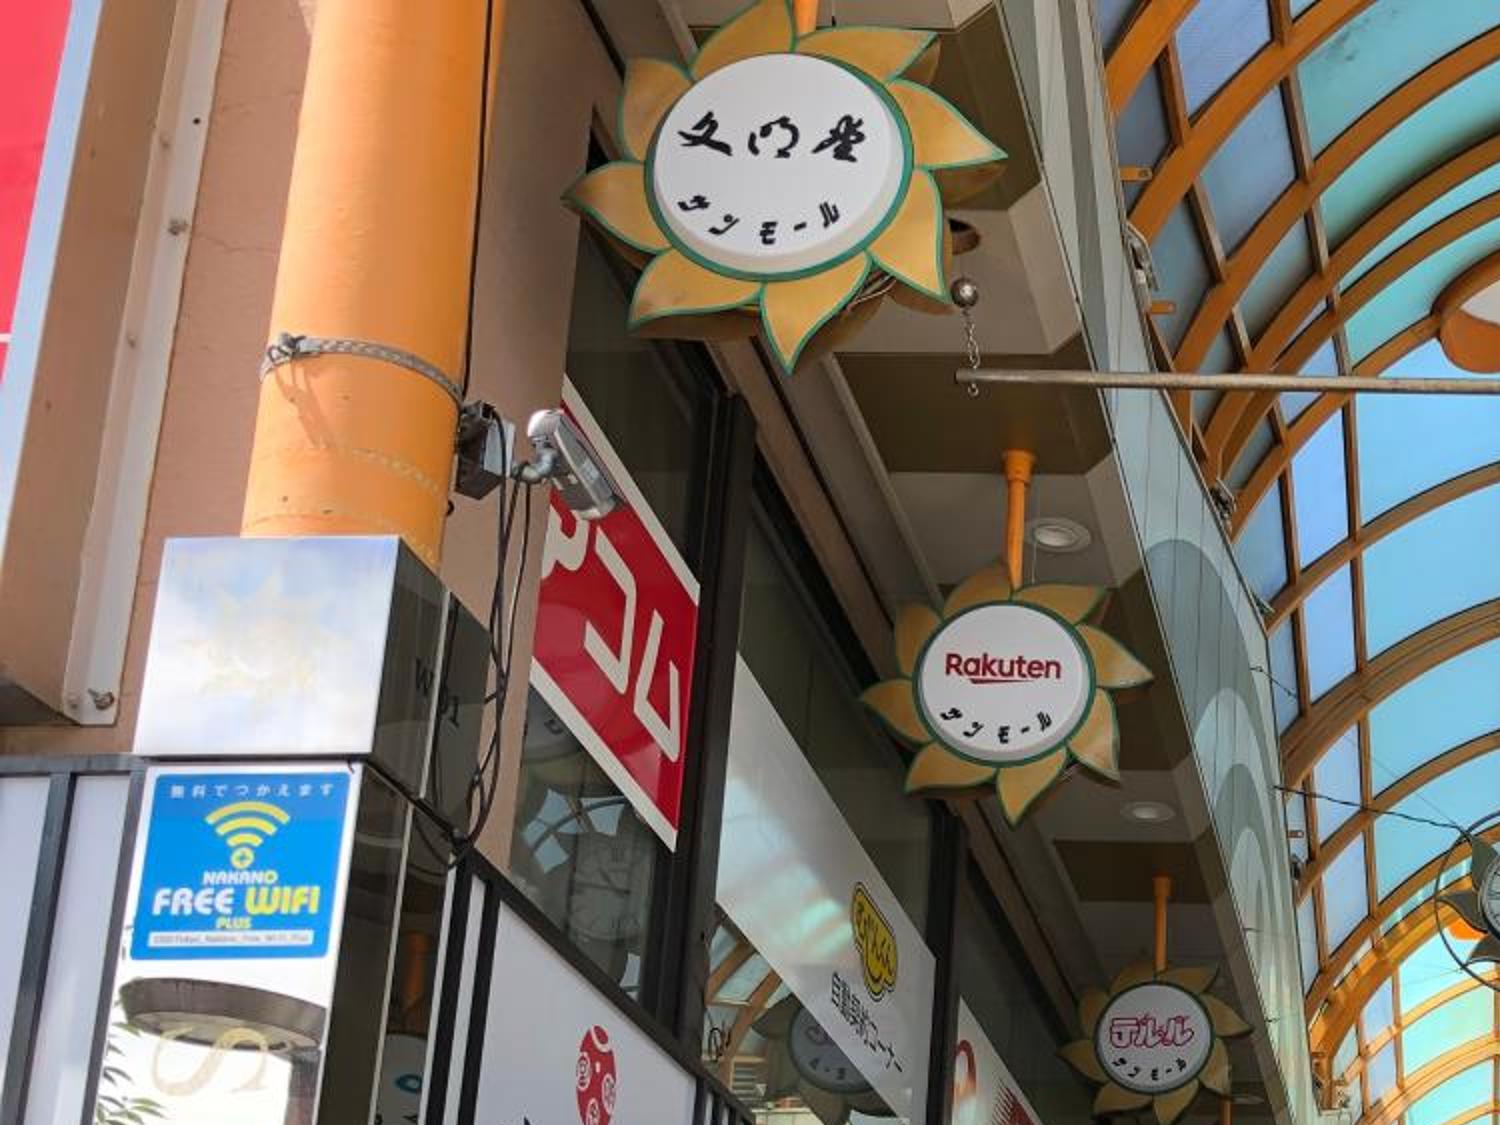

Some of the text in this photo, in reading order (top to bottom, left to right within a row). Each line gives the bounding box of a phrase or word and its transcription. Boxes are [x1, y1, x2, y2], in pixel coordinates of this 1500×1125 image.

[677, 194, 842, 246] サンモール
[944, 651, 1062, 685] Rakuten
[939, 707, 1053, 745] サンモール
[203, 870, 279, 886] NAKANO
[152, 886, 321, 916] FREE WIFI
[215, 917, 253, 930] PLUS
